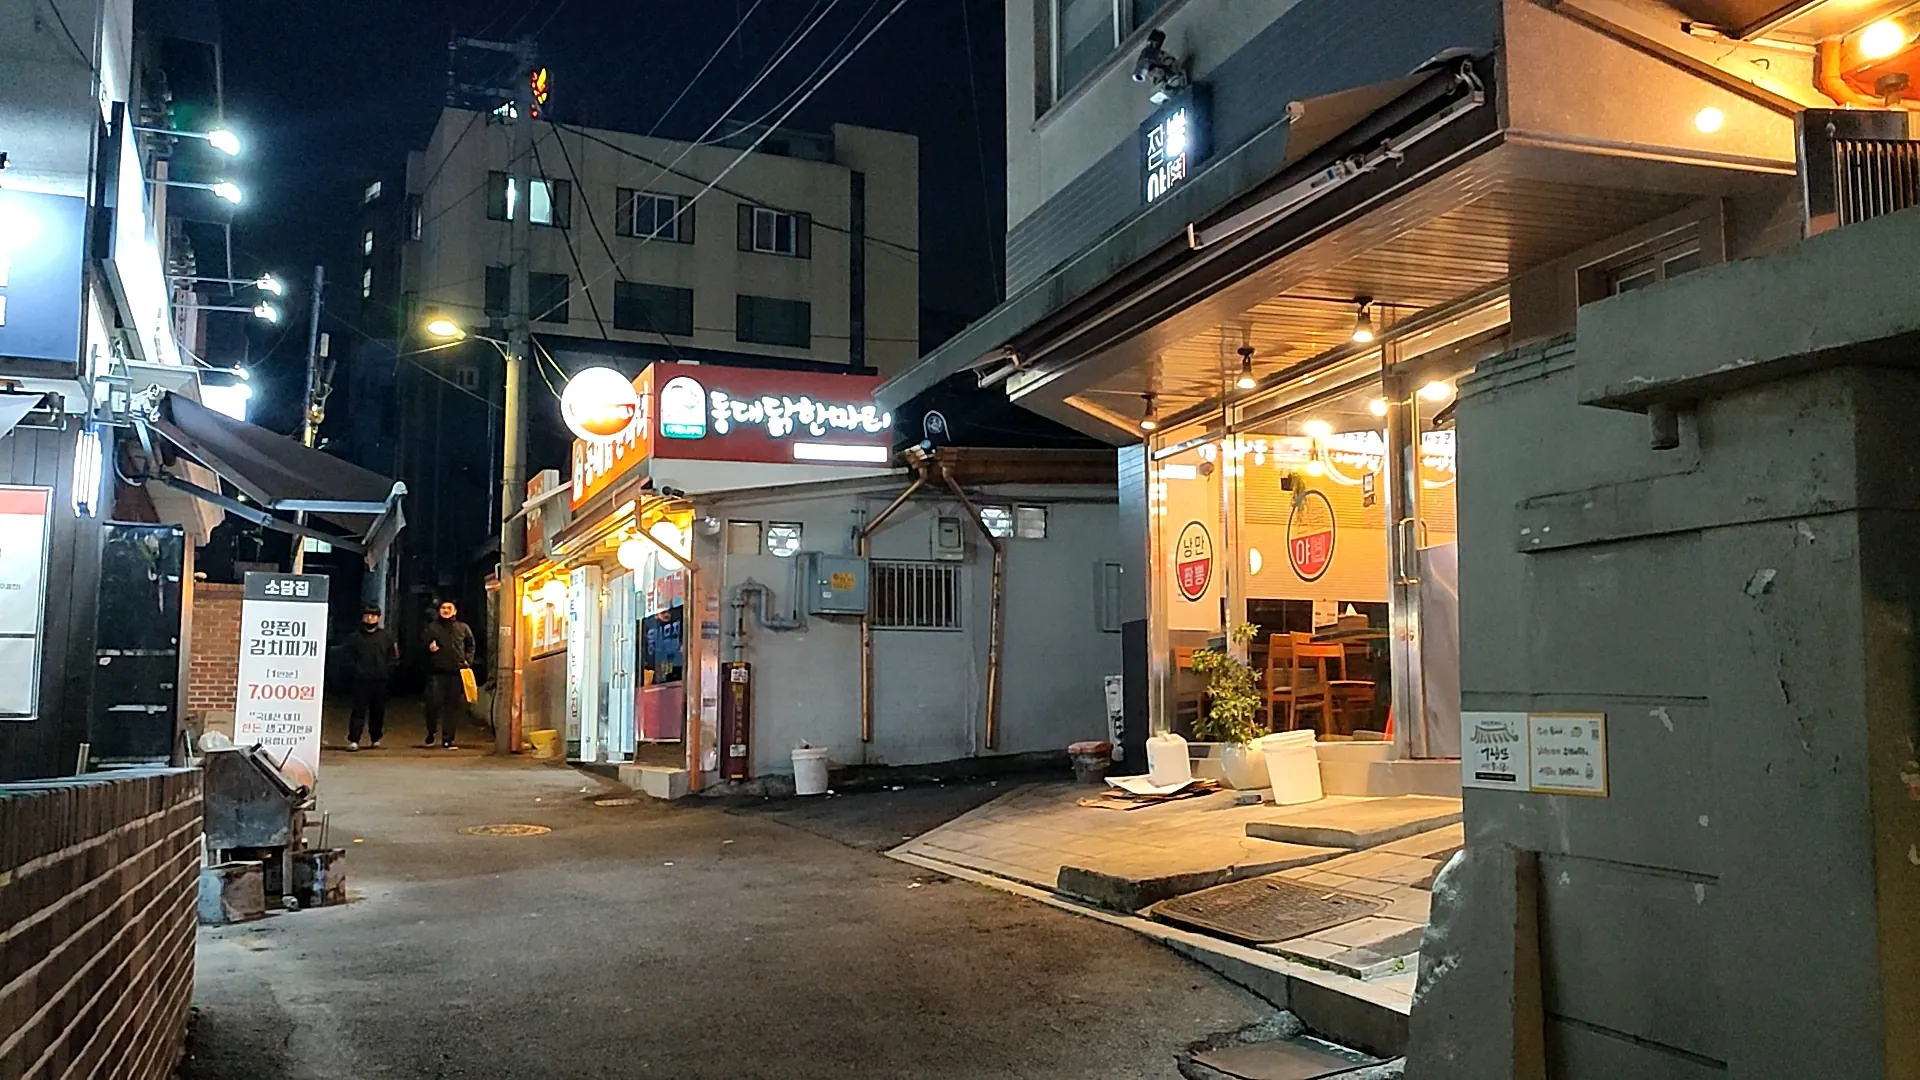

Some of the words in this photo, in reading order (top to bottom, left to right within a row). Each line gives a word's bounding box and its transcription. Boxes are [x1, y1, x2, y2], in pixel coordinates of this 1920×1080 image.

[1184, 535, 1204, 558] 낭만
[265, 579, 309, 597] 소담집
[260, 620, 306, 637] 양푼이
[250, 639, 317, 656] 김치찌개
